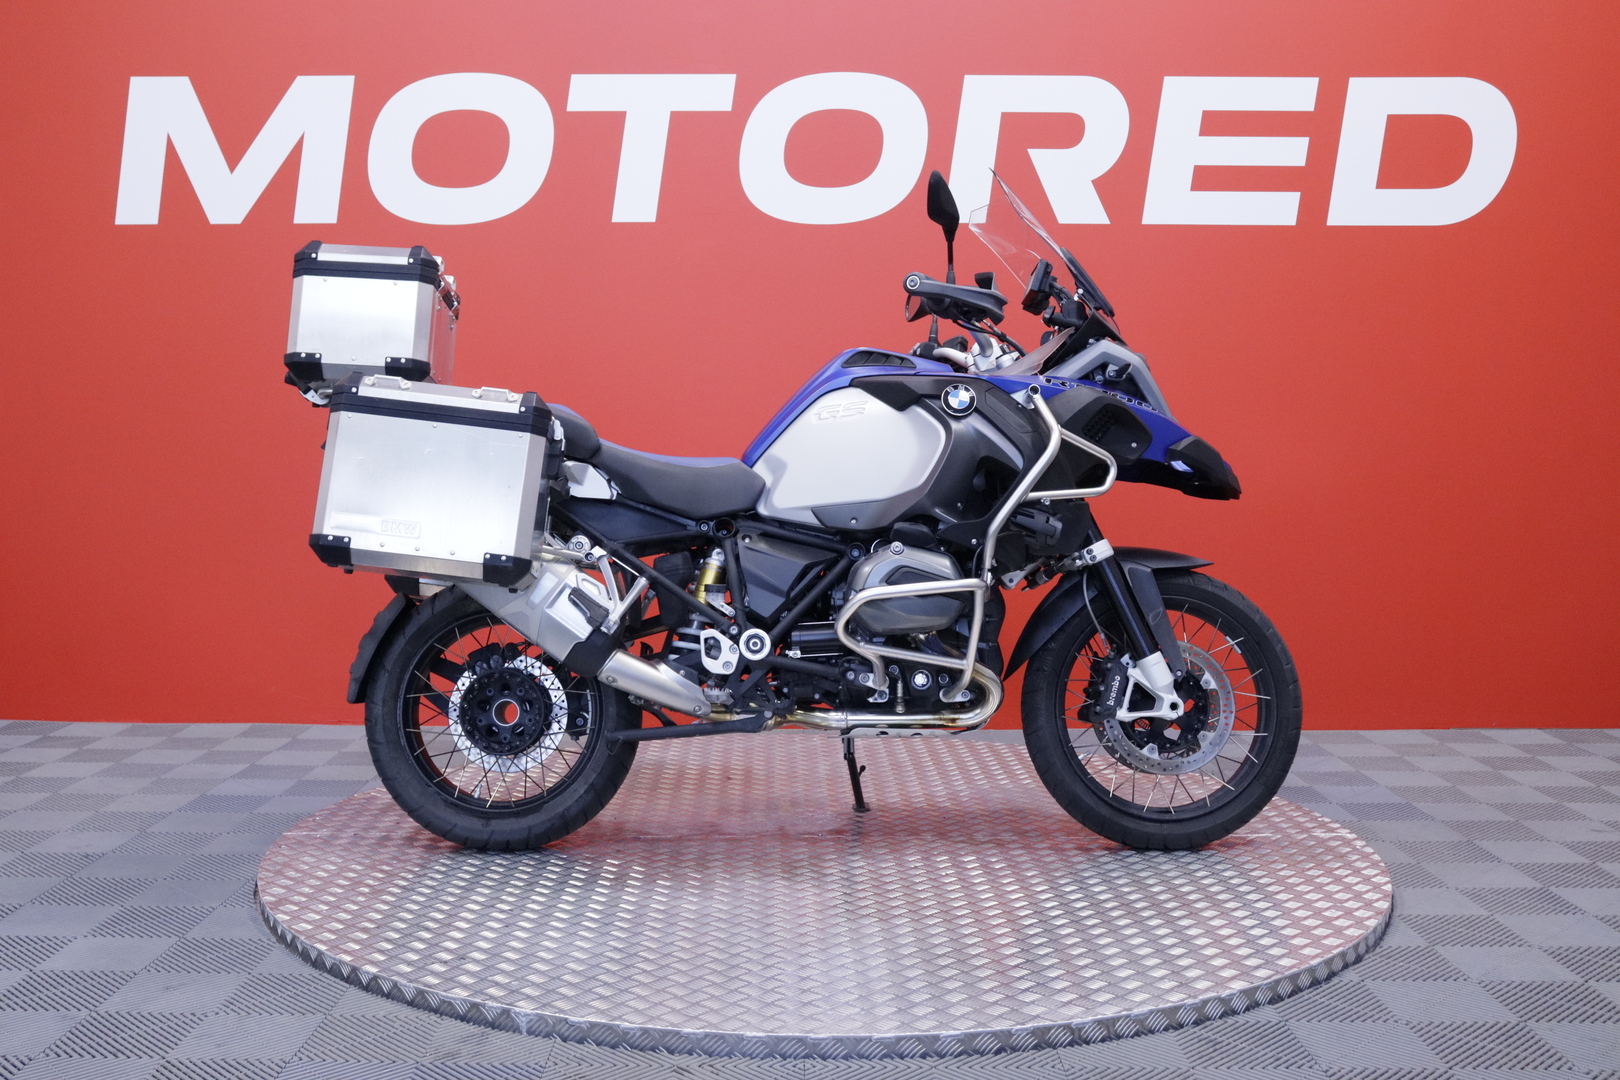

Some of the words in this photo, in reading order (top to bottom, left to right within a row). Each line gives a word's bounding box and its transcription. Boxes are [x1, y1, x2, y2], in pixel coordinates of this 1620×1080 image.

[115, 72, 1517, 225] MOTORED
[946, 384, 975, 396] BMW
[811, 400, 869, 424] GS
[381, 519, 418, 536] BMW
[1106, 675, 1121, 706] brembo
